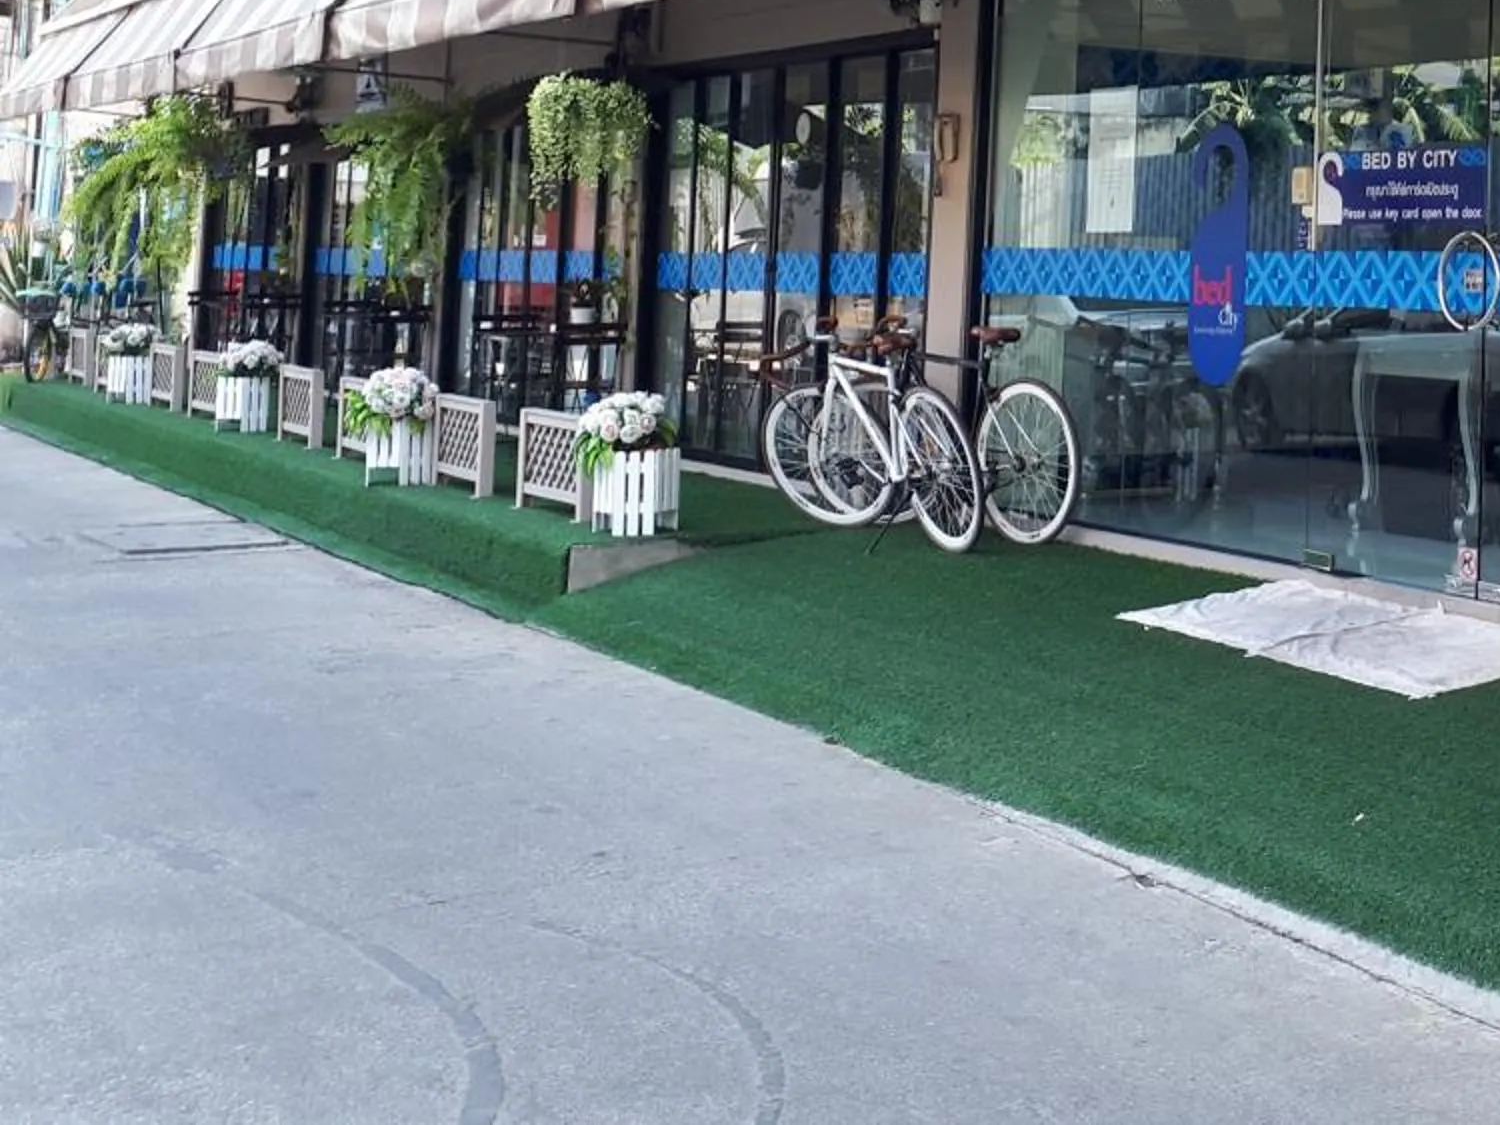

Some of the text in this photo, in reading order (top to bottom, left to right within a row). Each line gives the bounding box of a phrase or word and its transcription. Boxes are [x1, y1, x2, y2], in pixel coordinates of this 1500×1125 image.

[1361, 150, 1457, 170] BED BY CITY
[1445, 206, 1459, 219] the
[1193, 262, 1234, 306] bed
